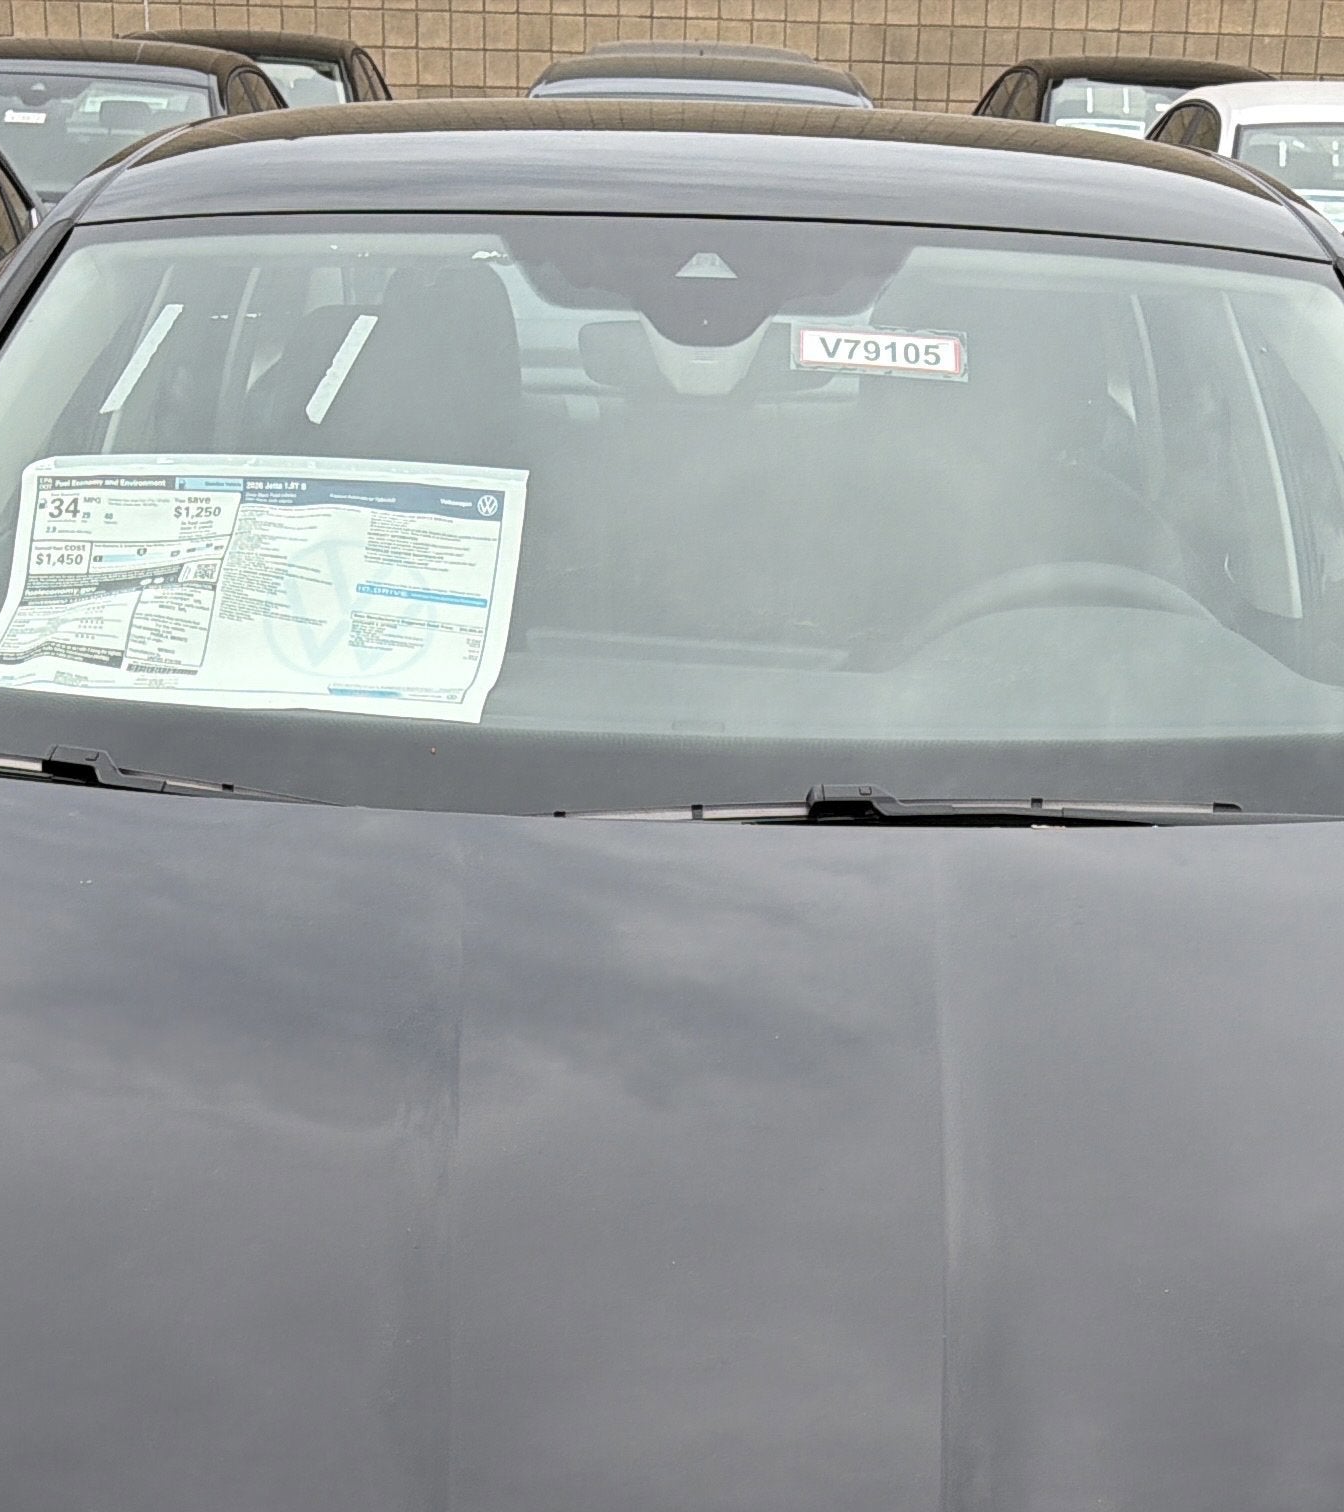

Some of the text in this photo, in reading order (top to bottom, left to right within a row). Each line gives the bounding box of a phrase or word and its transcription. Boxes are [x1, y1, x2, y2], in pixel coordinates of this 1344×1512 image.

[819, 336, 941, 366] V79105
[72, 479, 104, 487] Economy
[120, 478, 166, 487] Environment
[48, 497, 81, 518] 34
[173, 505, 222, 519] $1,250
[64, 544, 86, 552] COST
[35, 552, 84, 567] $1,450
